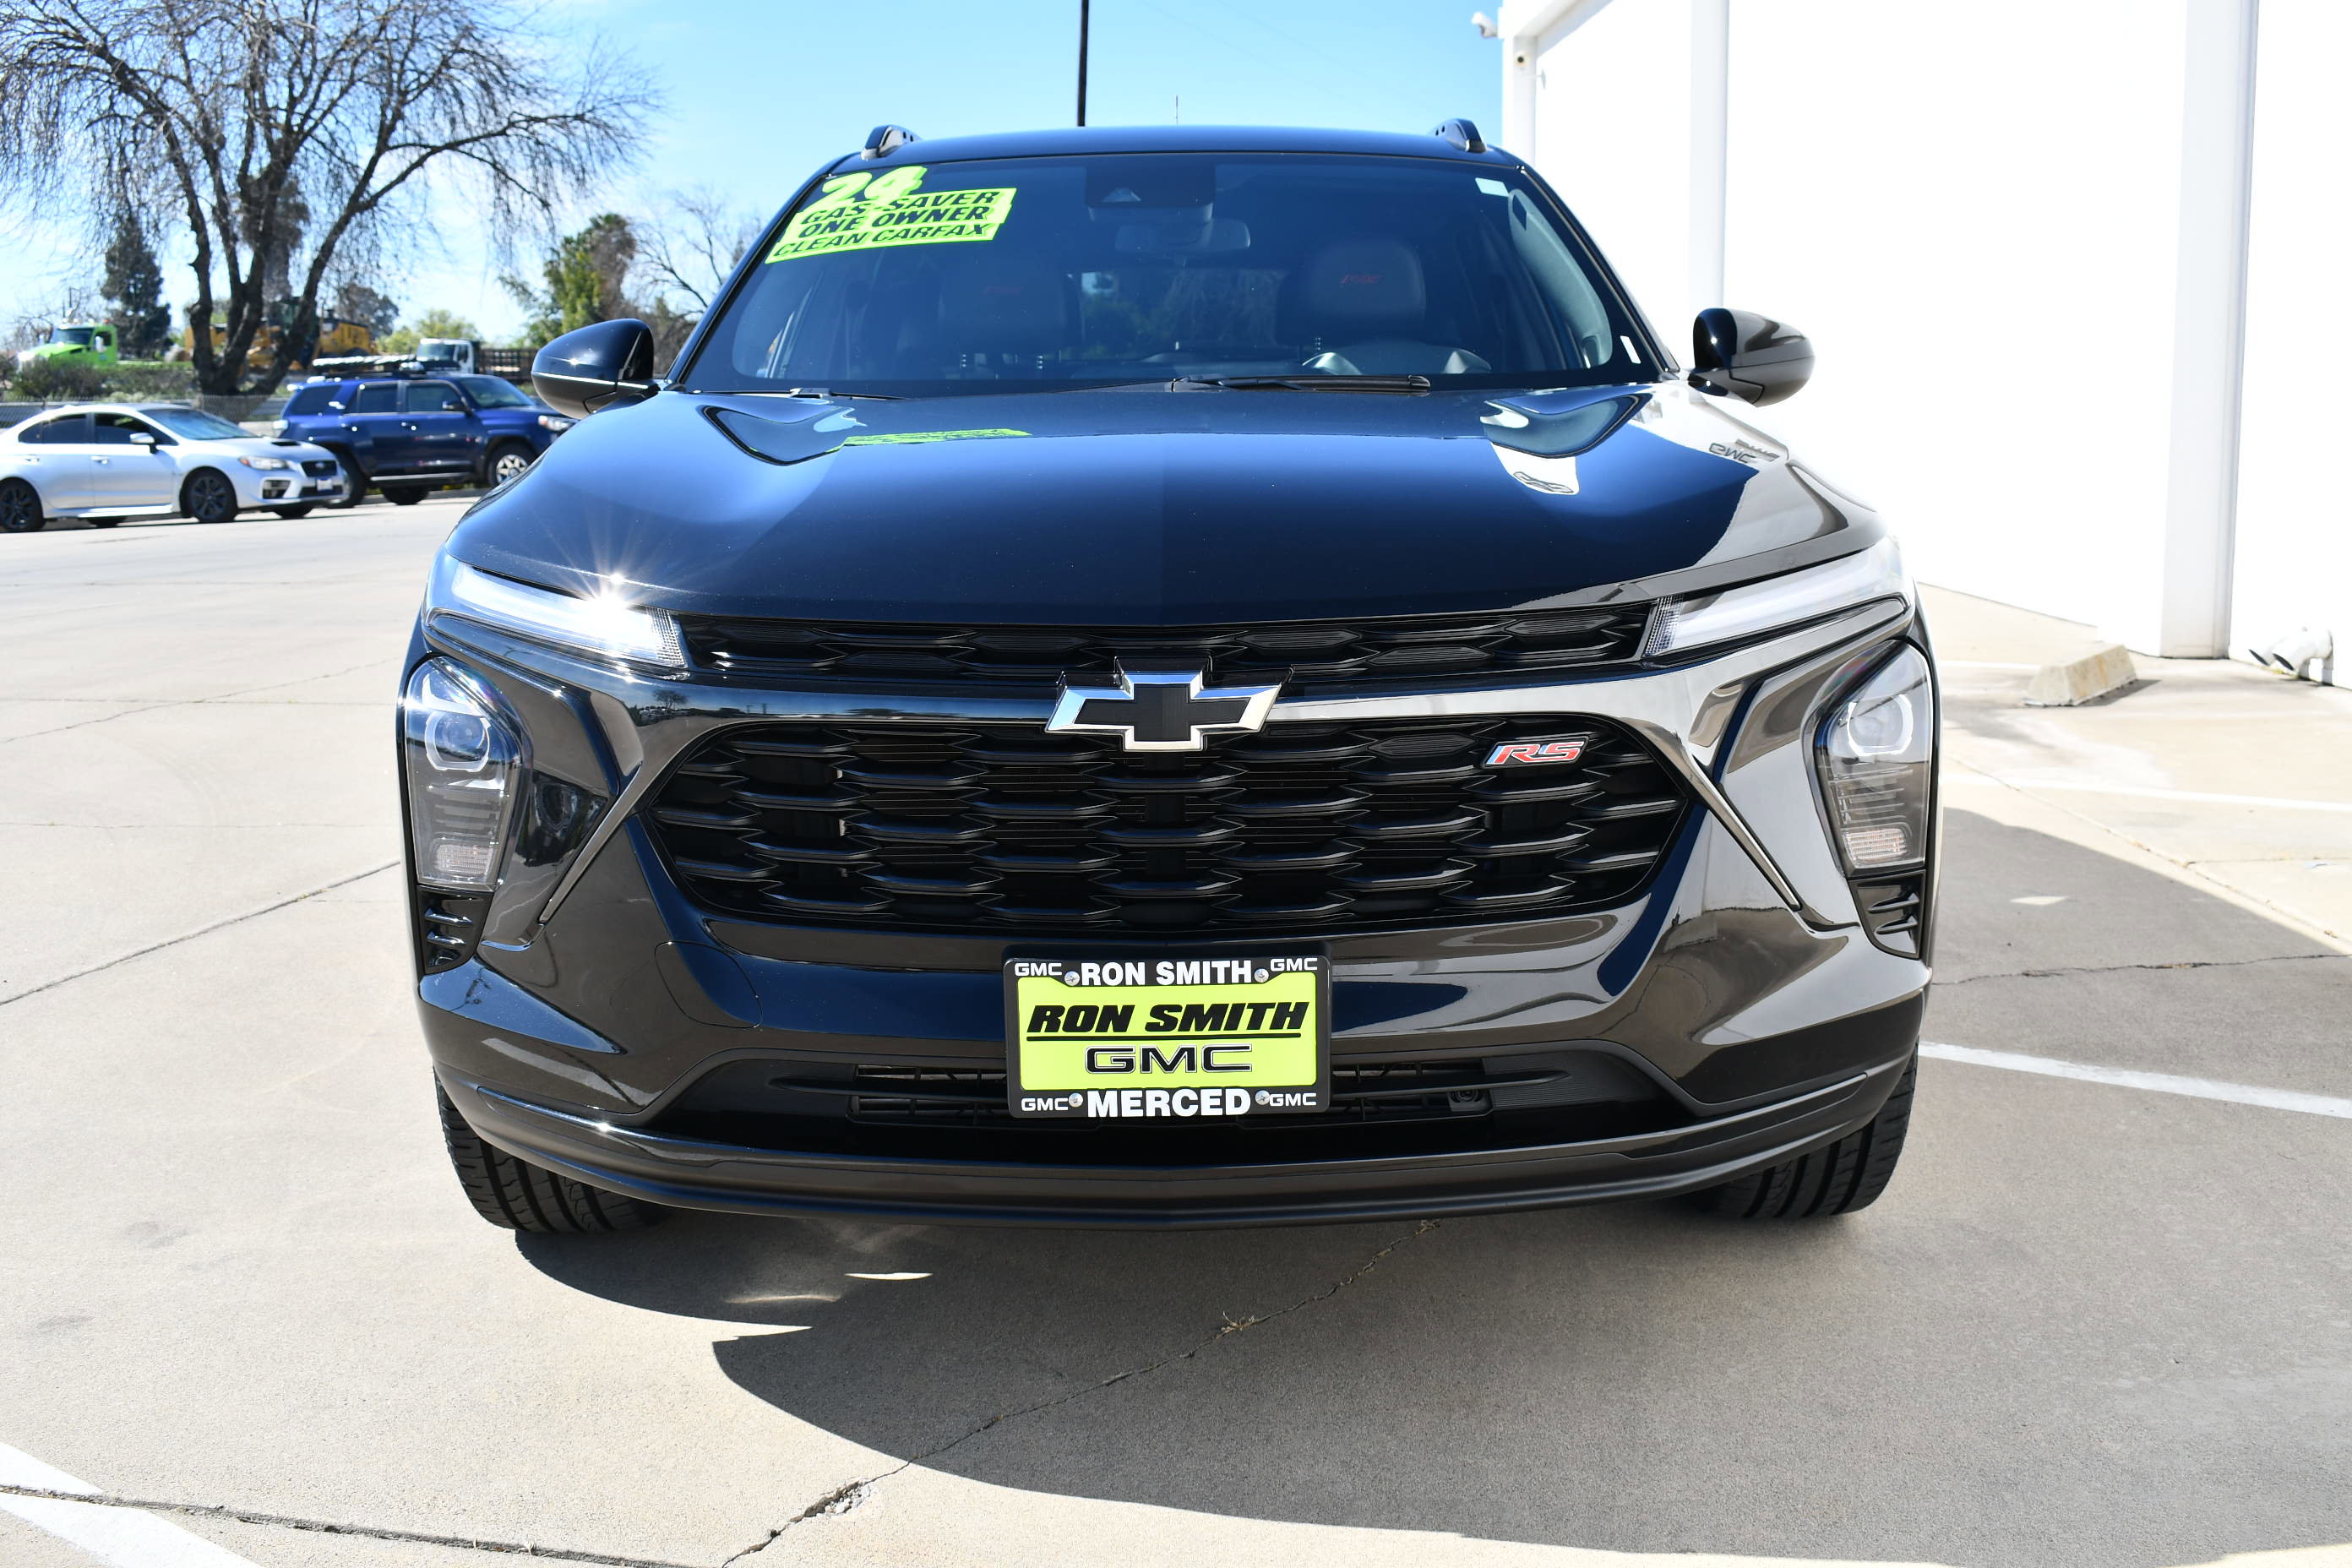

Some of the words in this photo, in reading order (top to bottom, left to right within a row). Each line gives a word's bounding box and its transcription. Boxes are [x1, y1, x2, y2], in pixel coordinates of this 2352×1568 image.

[813, 166, 928, 204] 24
[798, 216, 866, 238] ONE
[872, 206, 990, 227] OWNER
[773, 232, 869, 256] CLEAN
[872, 224, 989, 242] CARFAX
[1486, 741, 1585, 764] RS
[1015, 962, 1063, 977] GMC
[1081, 961, 1146, 986] RON
[1156, 960, 1252, 985] SMITH
[1270, 957, 1318, 972] GMC
[1026, 1004, 1135, 1033] RON
[1145, 1001, 1309, 1032] SMITH
[1085, 1043, 1253, 1075] GMC
[1021, 1097, 1070, 1112] GMC
[1086, 1089, 1251, 1118] MERCED
[1269, 1092, 1317, 1107] GMC
